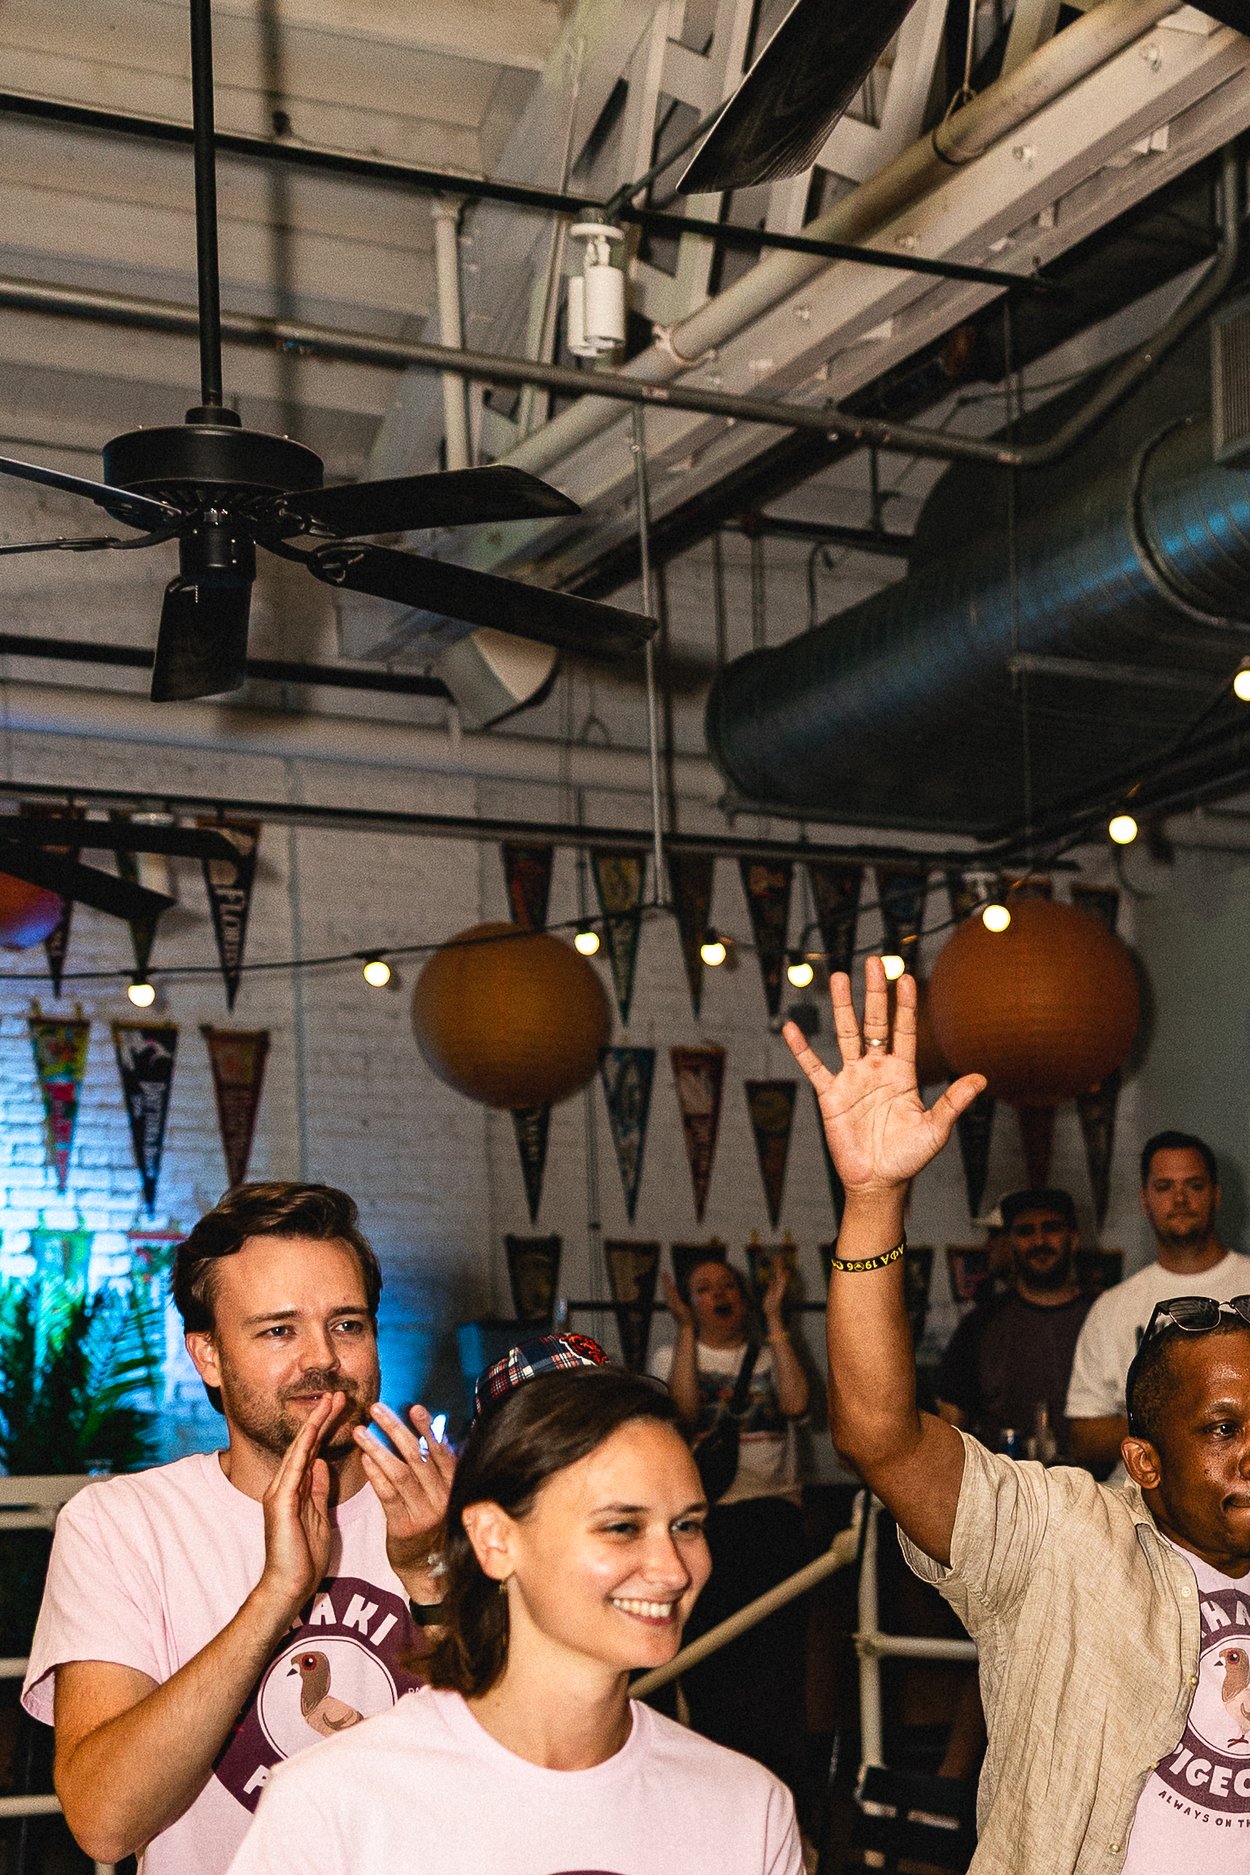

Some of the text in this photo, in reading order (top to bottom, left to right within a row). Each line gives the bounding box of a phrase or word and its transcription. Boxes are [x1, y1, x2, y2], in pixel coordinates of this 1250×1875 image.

[309, 1593, 398, 1646] AKI
[1158, 1790, 1210, 1823] ALWAYS
[1215, 1818, 1232, 1828] ON
